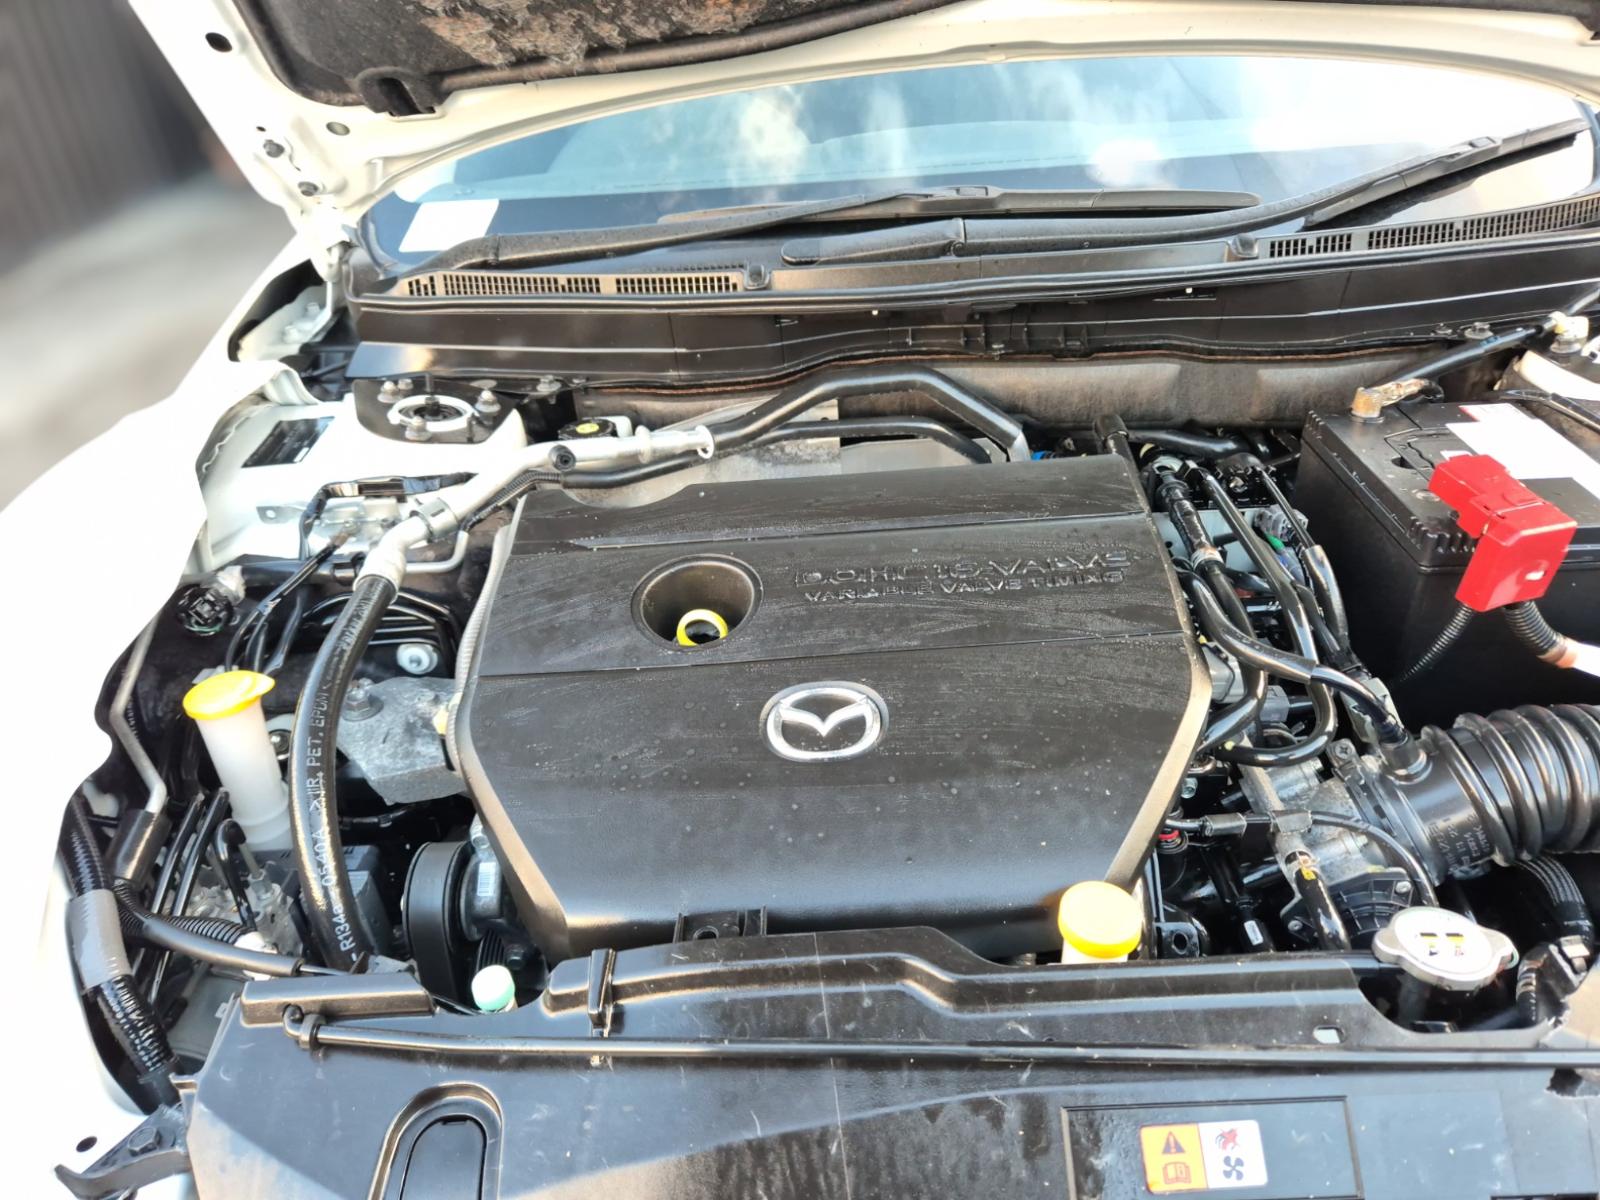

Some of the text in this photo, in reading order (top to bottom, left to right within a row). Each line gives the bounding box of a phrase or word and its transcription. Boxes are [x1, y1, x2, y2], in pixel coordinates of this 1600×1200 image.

[803, 568, 1125, 601] VARIABLE VALVE TIMING
